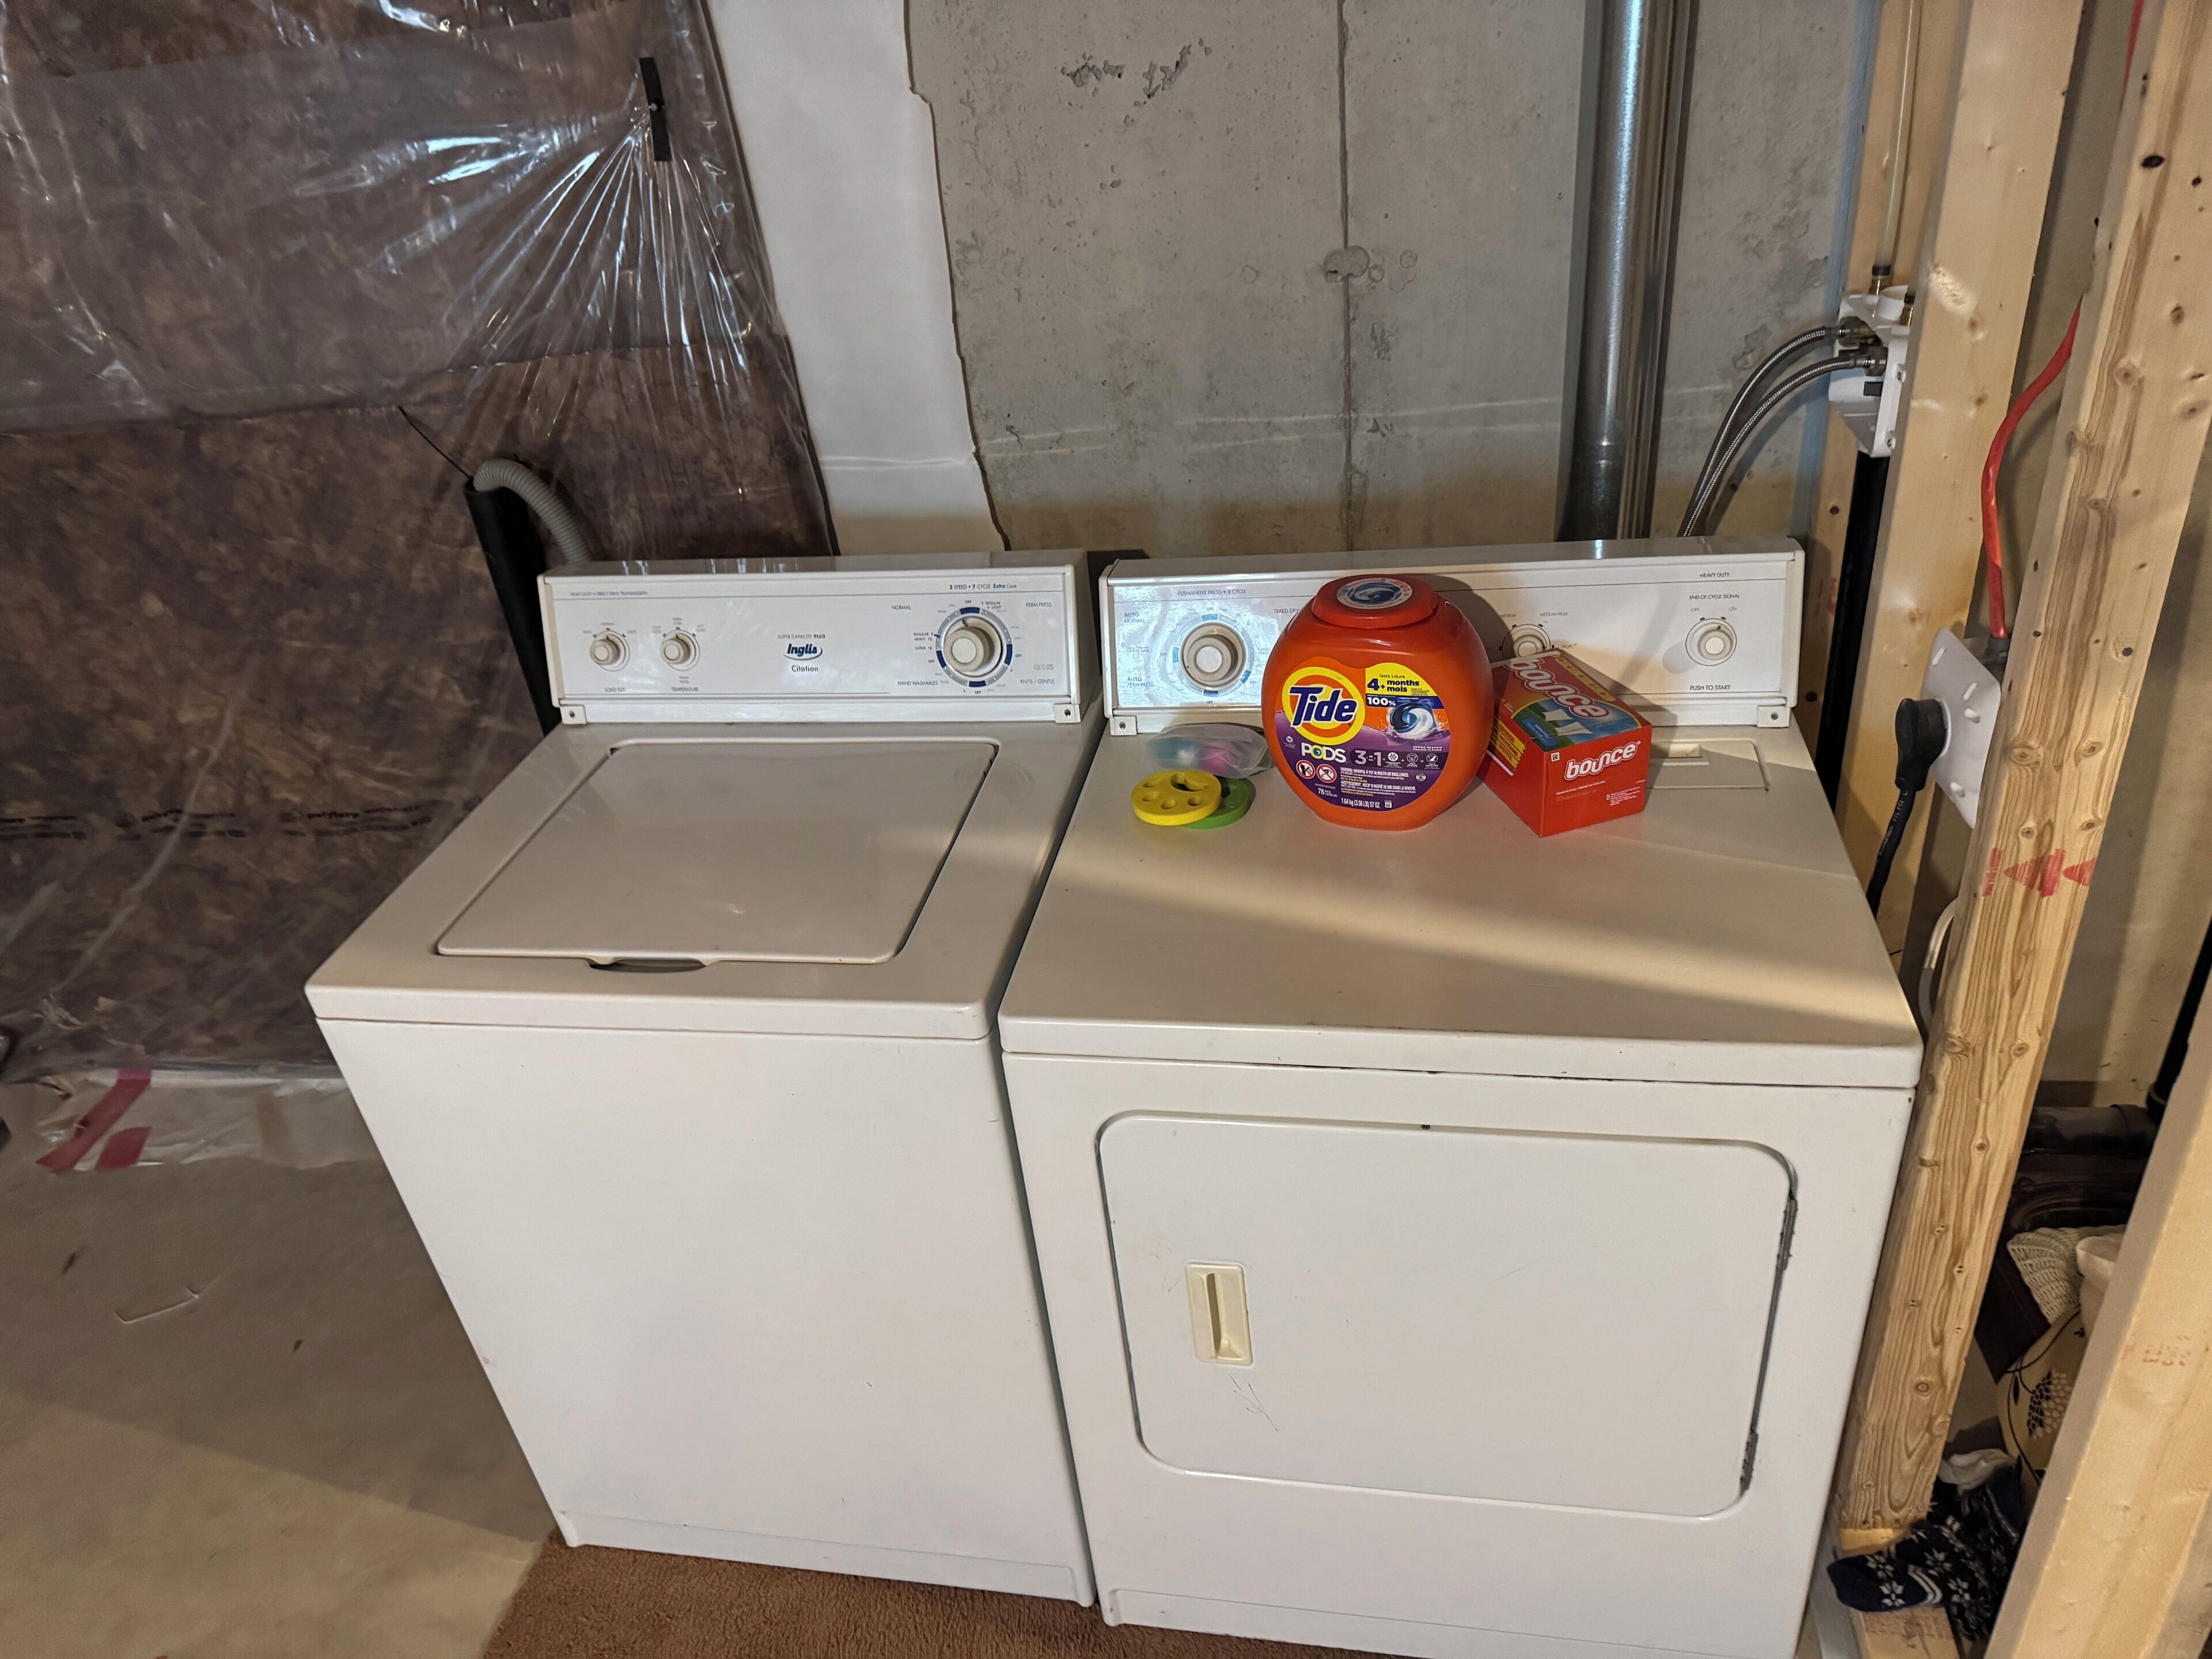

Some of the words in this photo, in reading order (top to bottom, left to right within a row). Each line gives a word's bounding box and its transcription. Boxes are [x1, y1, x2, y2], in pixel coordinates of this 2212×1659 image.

[786, 643, 818, 657] Inglis
[1367, 696, 1396, 706] 100%
[1510, 658, 1609, 718] bounce
[1289, 686, 1358, 728] Tide
[1301, 742, 1347, 763] PODS
[1565, 743, 1638, 781] bounce
